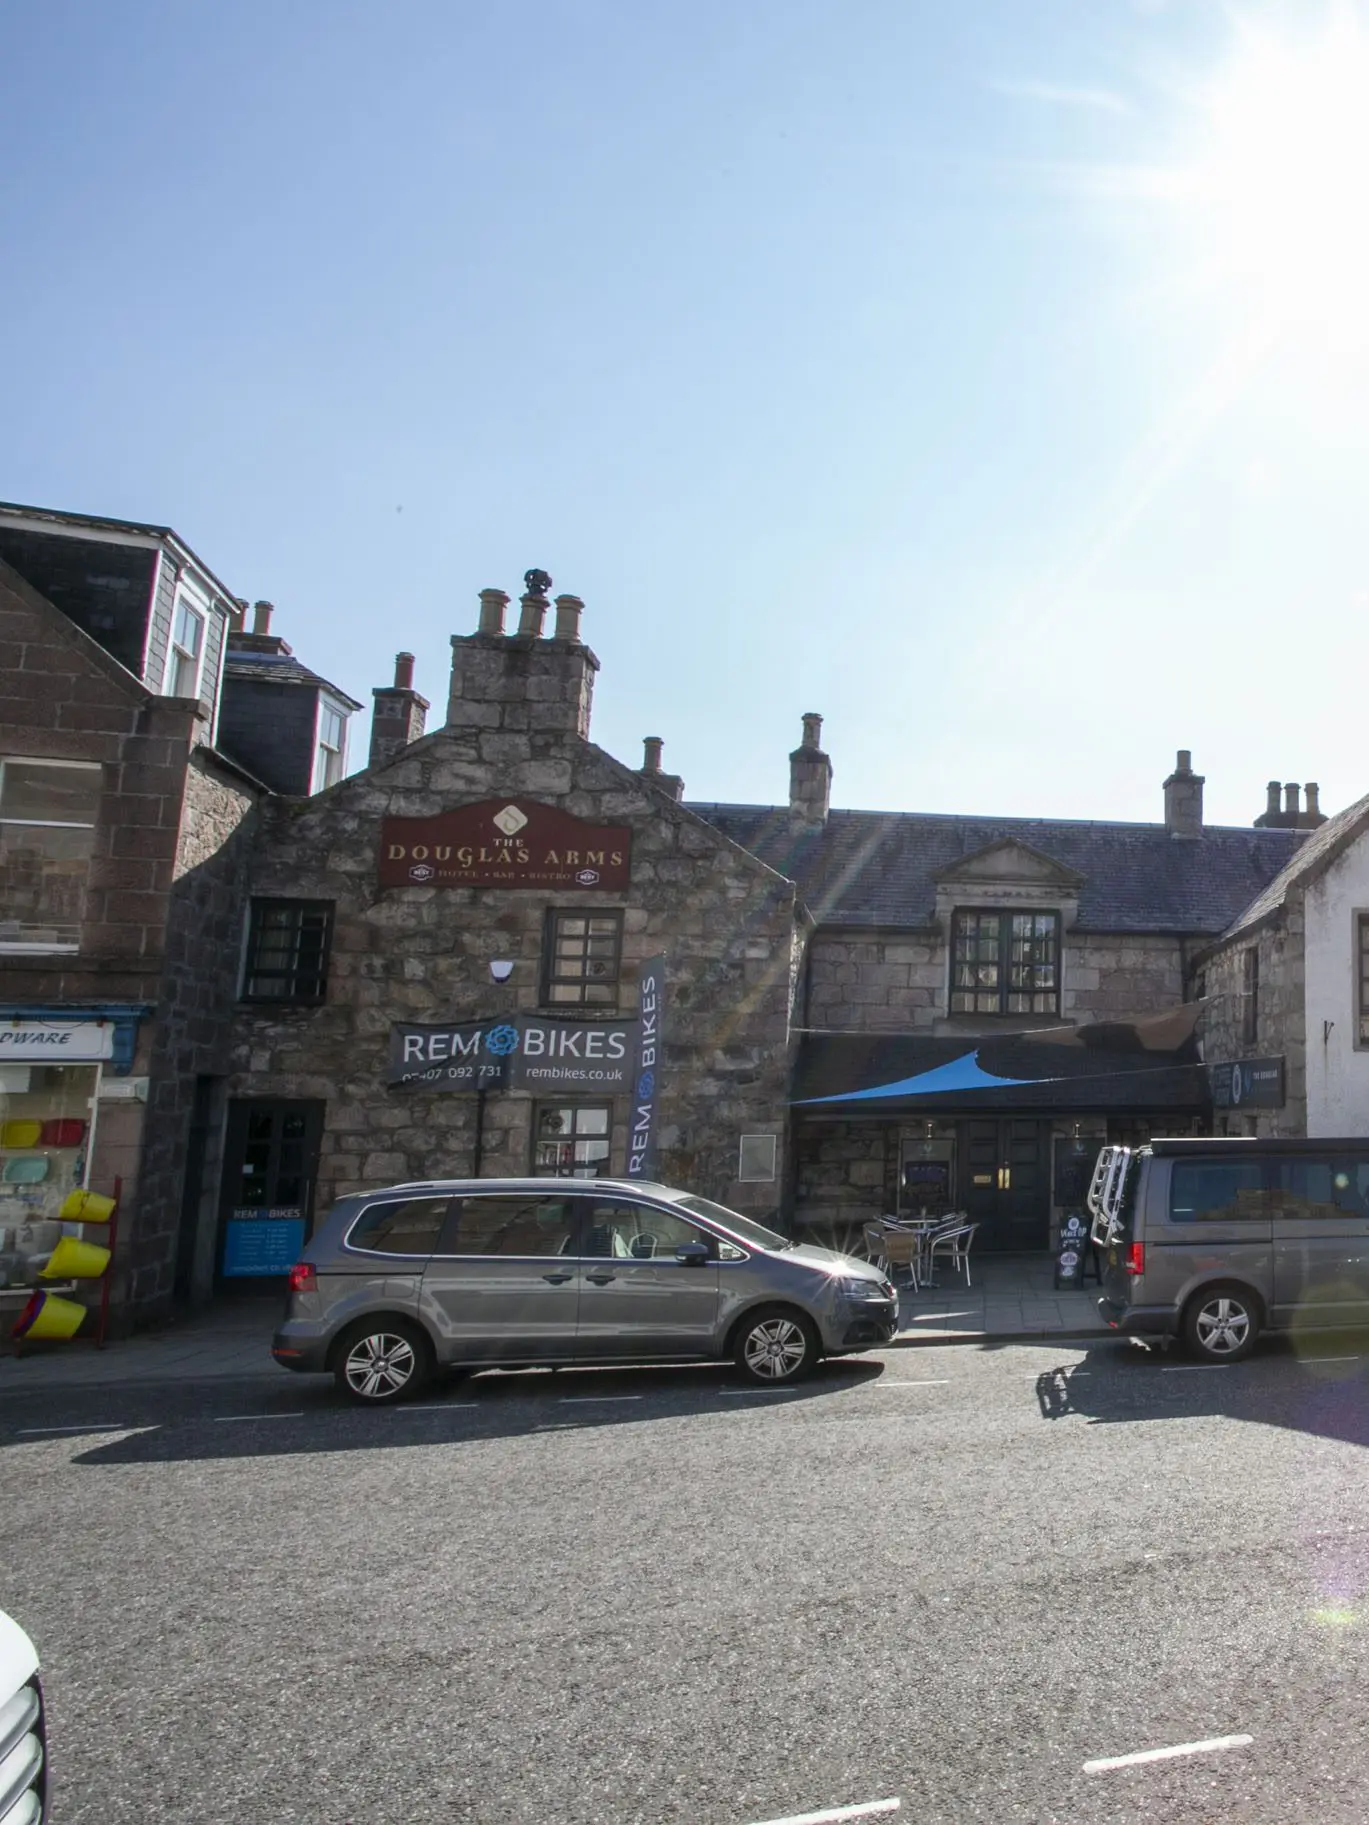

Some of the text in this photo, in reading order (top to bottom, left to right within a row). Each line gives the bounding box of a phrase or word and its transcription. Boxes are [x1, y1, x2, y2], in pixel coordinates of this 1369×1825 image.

[493, 838, 524, 847] THE
[388, 844, 623, 867] DOUGLAS ARMS
[438, 869, 478, 878] HOTEL
[529, 872, 571, 880] BISTRO
[403, 1028, 626, 1062] REM BIKES
[448, 1066, 473, 1078] 092
[479, 1065, 502, 1077] 731
[526, 1066, 622, 1081] rembikes.co.uk
[629, 975, 656, 1173] REM BIKES
[233, 1208, 301, 1219] REM BIKES
